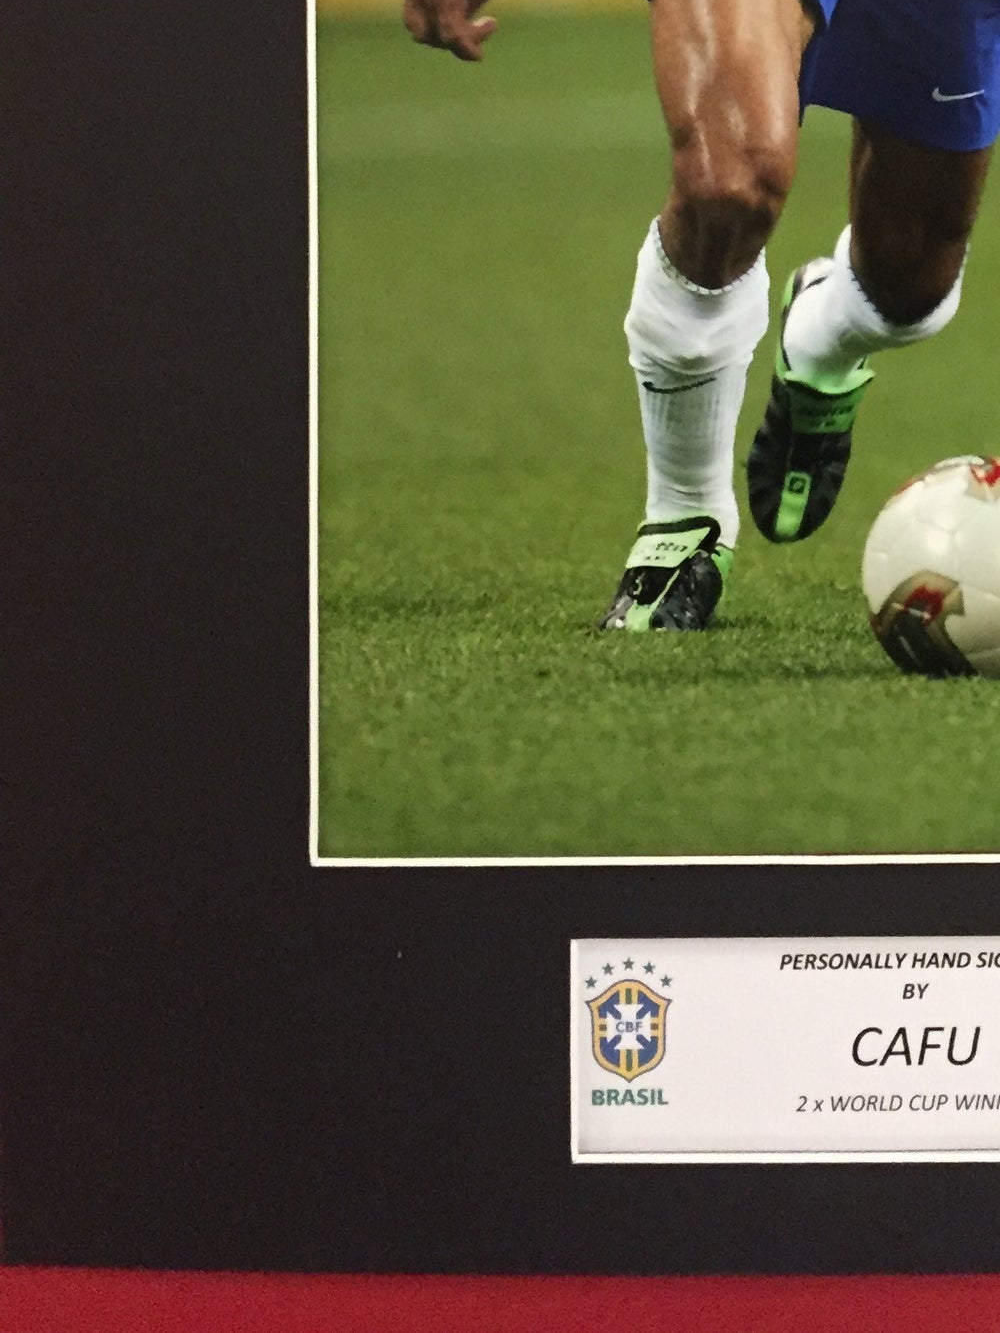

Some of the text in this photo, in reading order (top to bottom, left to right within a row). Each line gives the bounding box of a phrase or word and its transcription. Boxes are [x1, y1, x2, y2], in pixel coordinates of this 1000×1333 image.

[779, 952, 908, 970] PERSONALLY
[911, 952, 972, 969] HAND
[902, 983, 930, 1000] BY
[615, 1021, 643, 1033] CBF
[851, 1026, 981, 1067] CAFU
[591, 1088, 669, 1107] BRASIL
[795, 1095, 808, 1112] 2
[813, 1099, 824, 1112] x
[830, 1094, 903, 1112] WORLD
[908, 1094, 949, 1112] CUP
